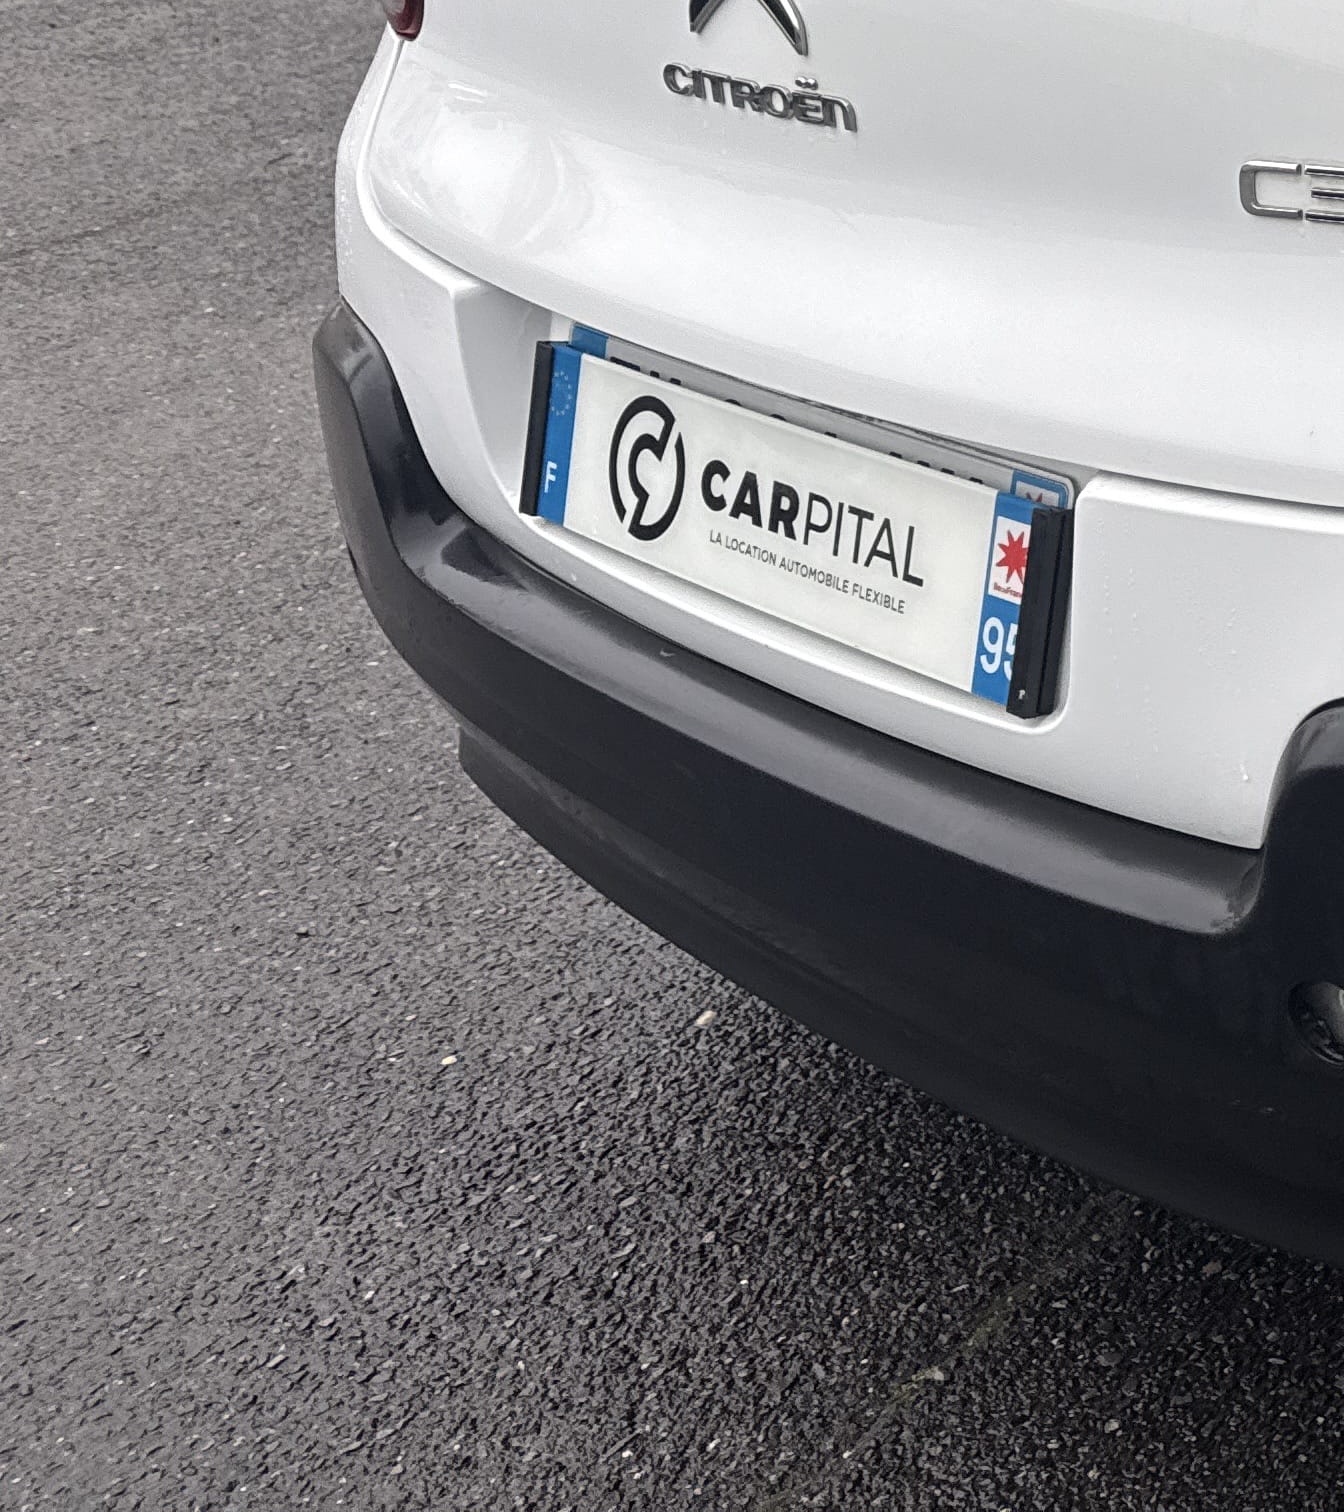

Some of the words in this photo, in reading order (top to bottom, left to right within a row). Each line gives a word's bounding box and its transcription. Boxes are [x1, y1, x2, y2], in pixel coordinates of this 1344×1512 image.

[663, 62, 858, 133] CITROËN
[544, 461, 557, 493] F
[701, 459, 924, 587] CARPITAL
[709, 529, 722, 545] LA
[725, 535, 777, 566] LOCATION
[779, 557, 849, 594] AUTOMOBILE
[852, 583, 906, 614] FLEXIBLE
